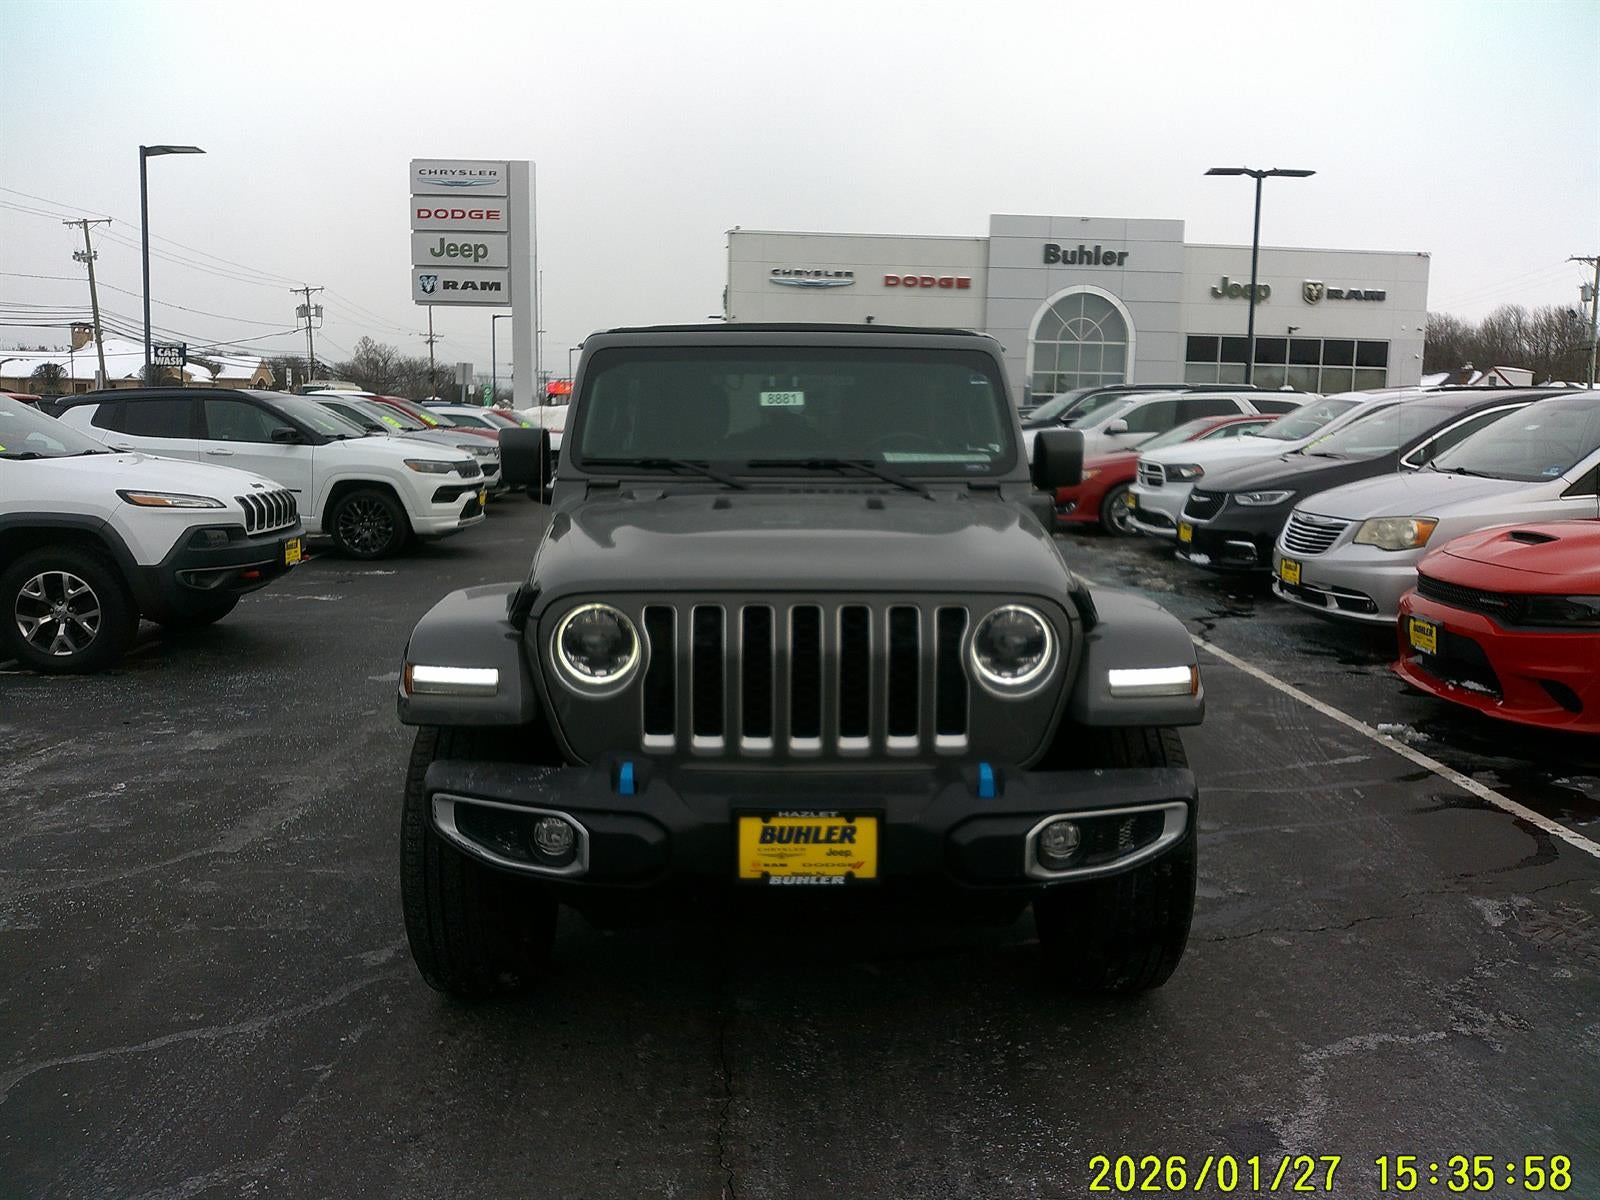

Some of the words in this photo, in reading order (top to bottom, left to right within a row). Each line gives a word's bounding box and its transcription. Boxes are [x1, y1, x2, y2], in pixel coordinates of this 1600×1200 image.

[418, 168, 498, 177] CHRYSLER
[416, 208, 501, 220] DODGE
[429, 237, 489, 263] Jeep
[1043, 243, 1129, 267] Buhler
[771, 268, 854, 278] CHRYSLER
[442, 280, 502, 292] RAM
[884, 274, 972, 289] DODGE
[1326, 287, 1387, 302] RAM
[157, 347, 179, 357] CAR
[154, 356, 184, 366] WASH
[759, 825, 858, 845] BUHLER
[826, 848, 853, 858] Jeep
[769, 875, 846, 885] BUHLER
